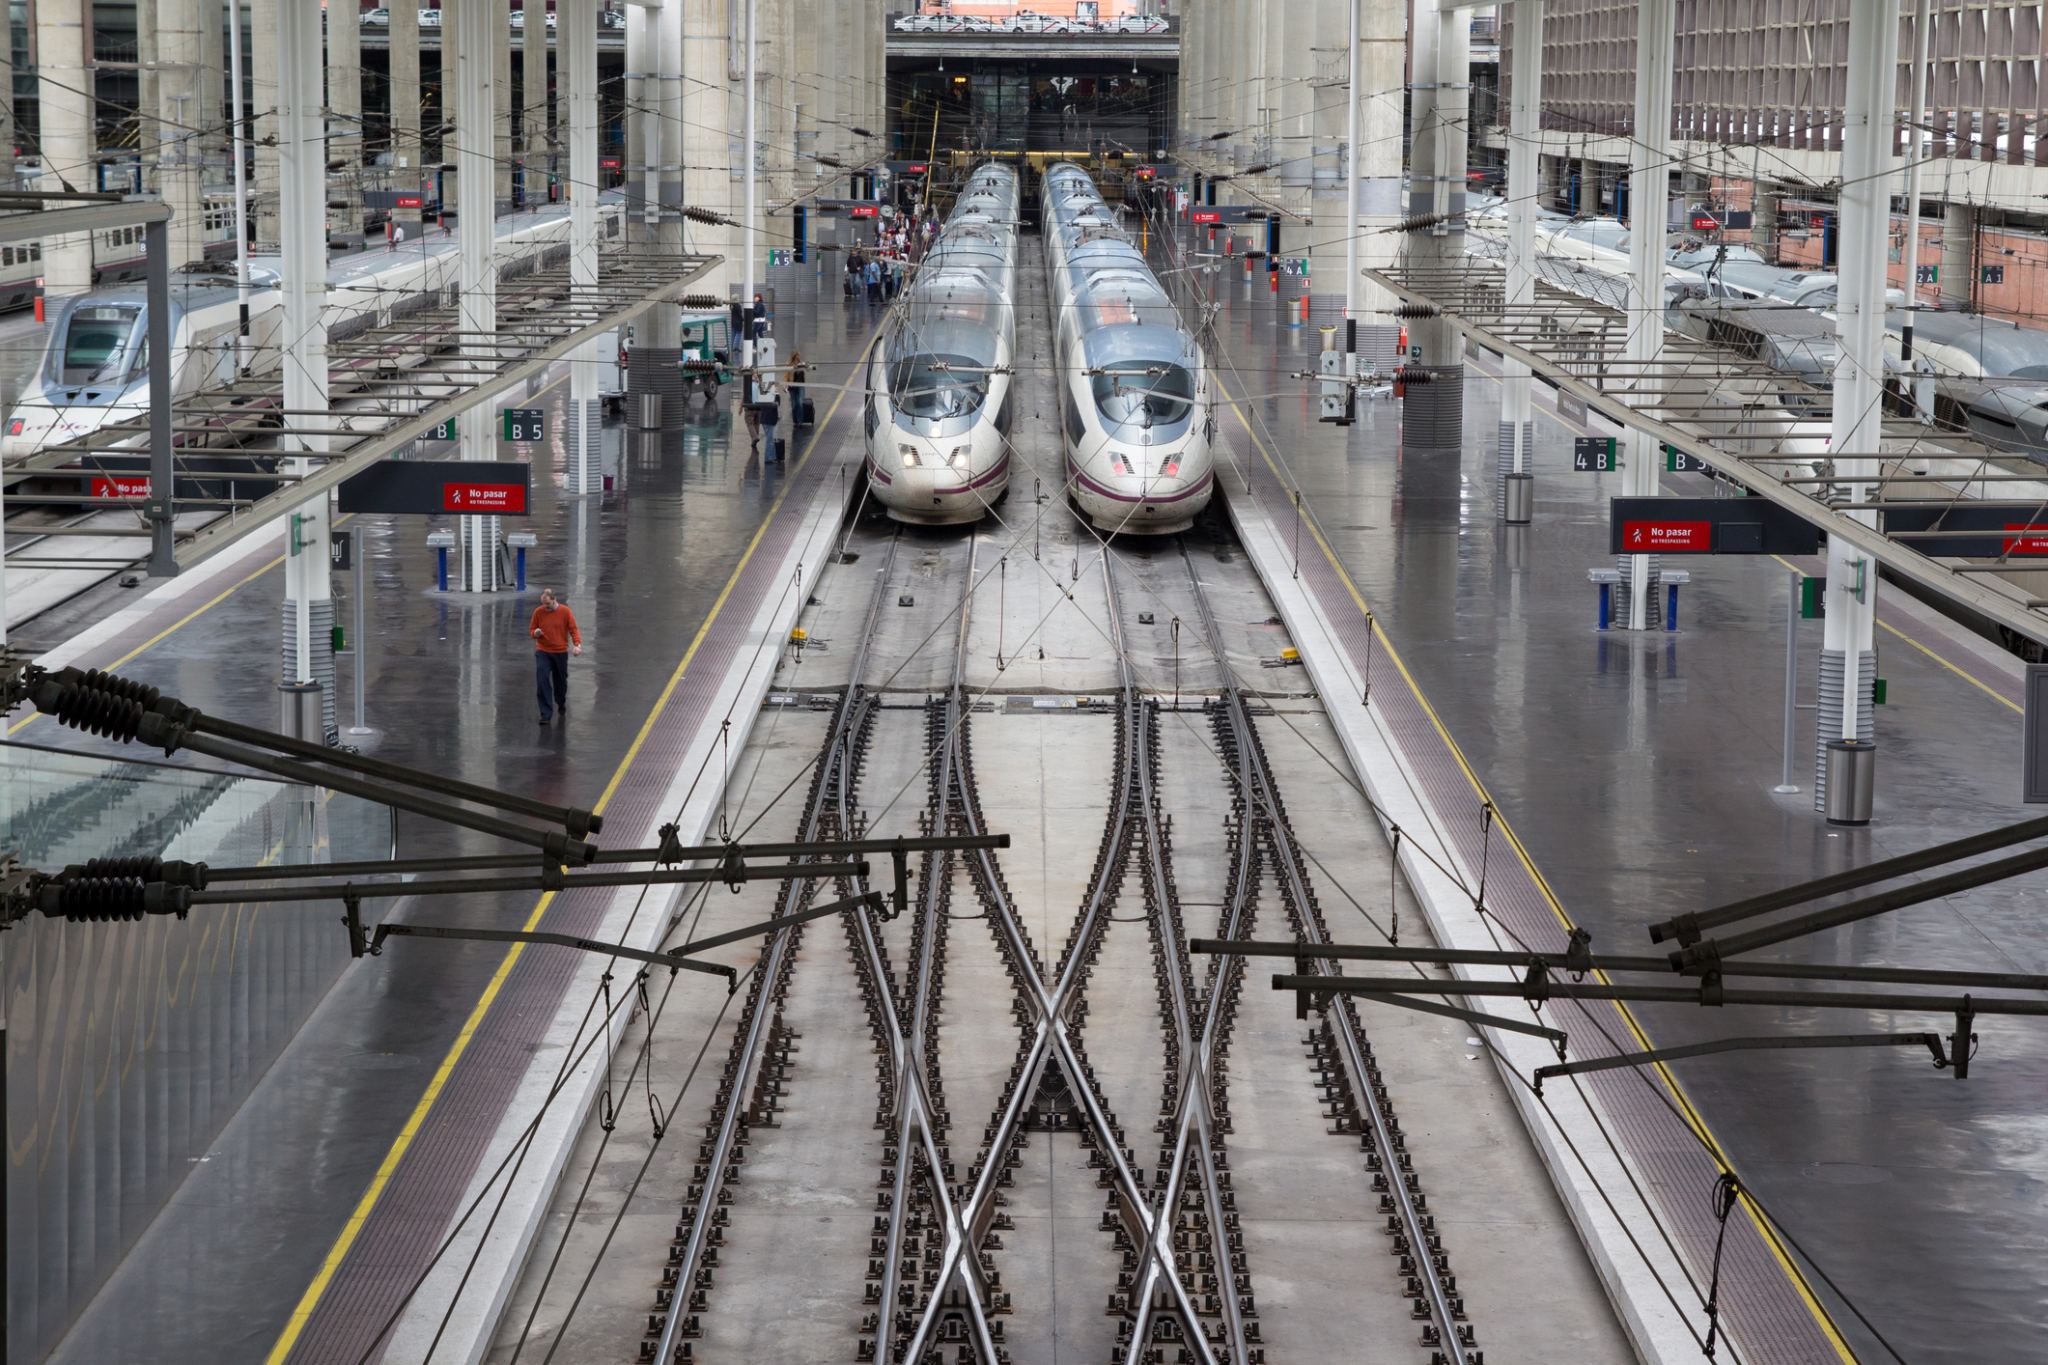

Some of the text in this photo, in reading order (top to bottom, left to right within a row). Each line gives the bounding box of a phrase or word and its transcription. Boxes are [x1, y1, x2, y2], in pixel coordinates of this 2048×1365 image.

[774, 257, 780, 265] A
[1286, 266, 1303, 275] 4 A
[1917, 274, 1934, 283] 2 A
[1985, 274, 2002, 283] A 1
[437, 423, 447, 439] B
[512, 424, 542, 440] B 5
[1576, 453, 1607, 470] 4 B
[1676, 453, 1686, 470] B
[118, 484, 130, 493] No
[469, 488, 508, 499] No pasar
[1651, 527, 1693, 538] No pasar
